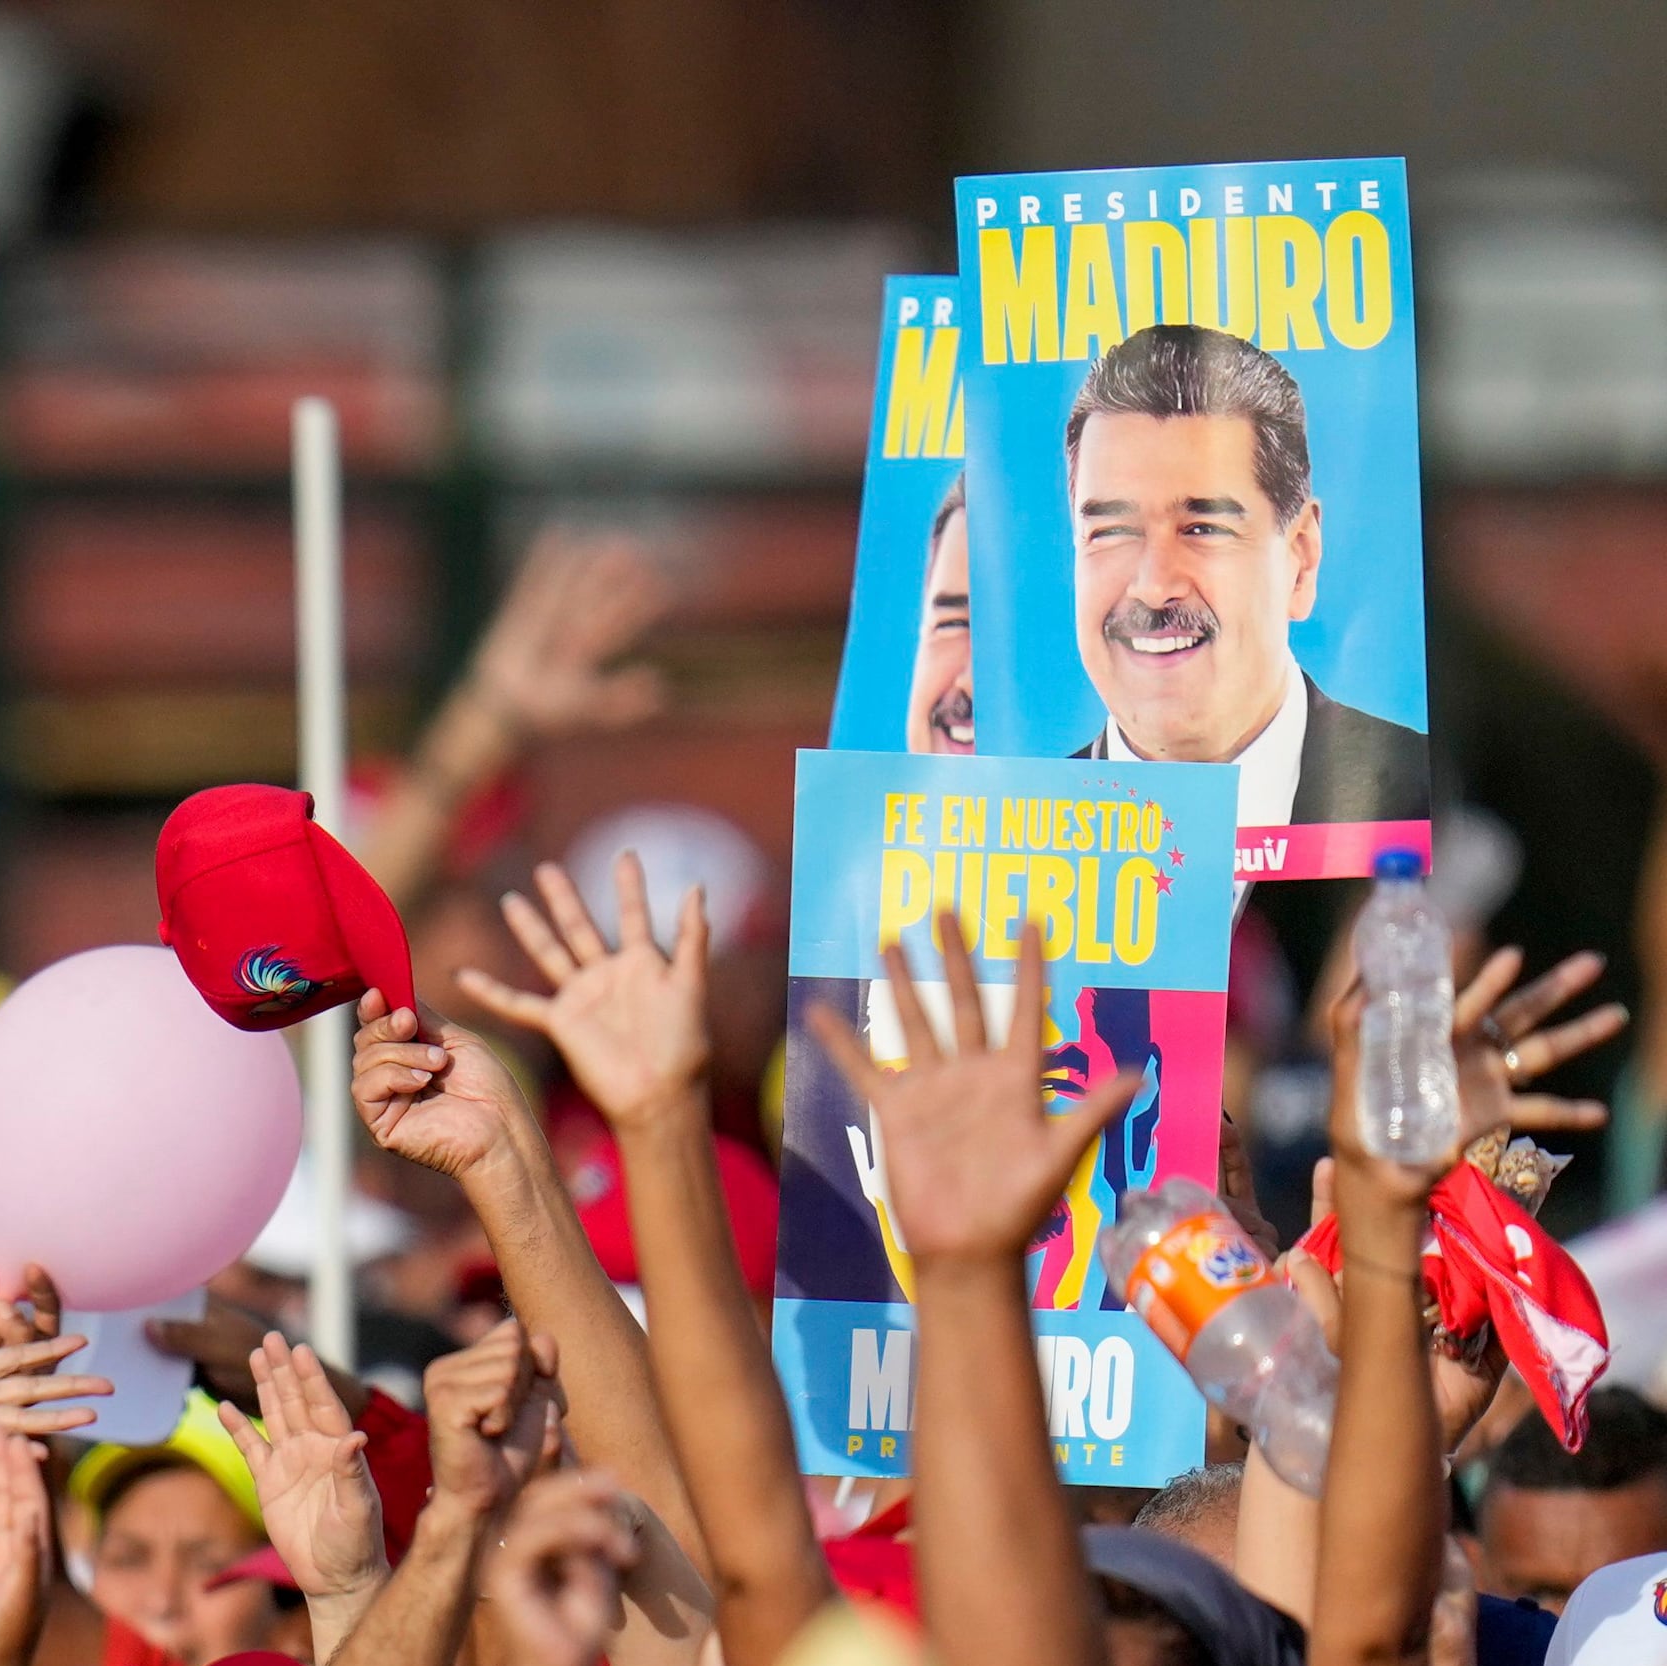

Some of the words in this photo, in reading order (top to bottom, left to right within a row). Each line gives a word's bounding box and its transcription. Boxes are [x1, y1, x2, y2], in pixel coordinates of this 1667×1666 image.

[977, 180, 1380, 226] PRESIDENTE
[979, 210, 1392, 365] MADURO
[883, 793, 927, 845] FE
[940, 795, 987, 847] EN
[1000, 797, 1163, 853] NUESTRO
[878, 849, 1161, 966] PUEBLO
